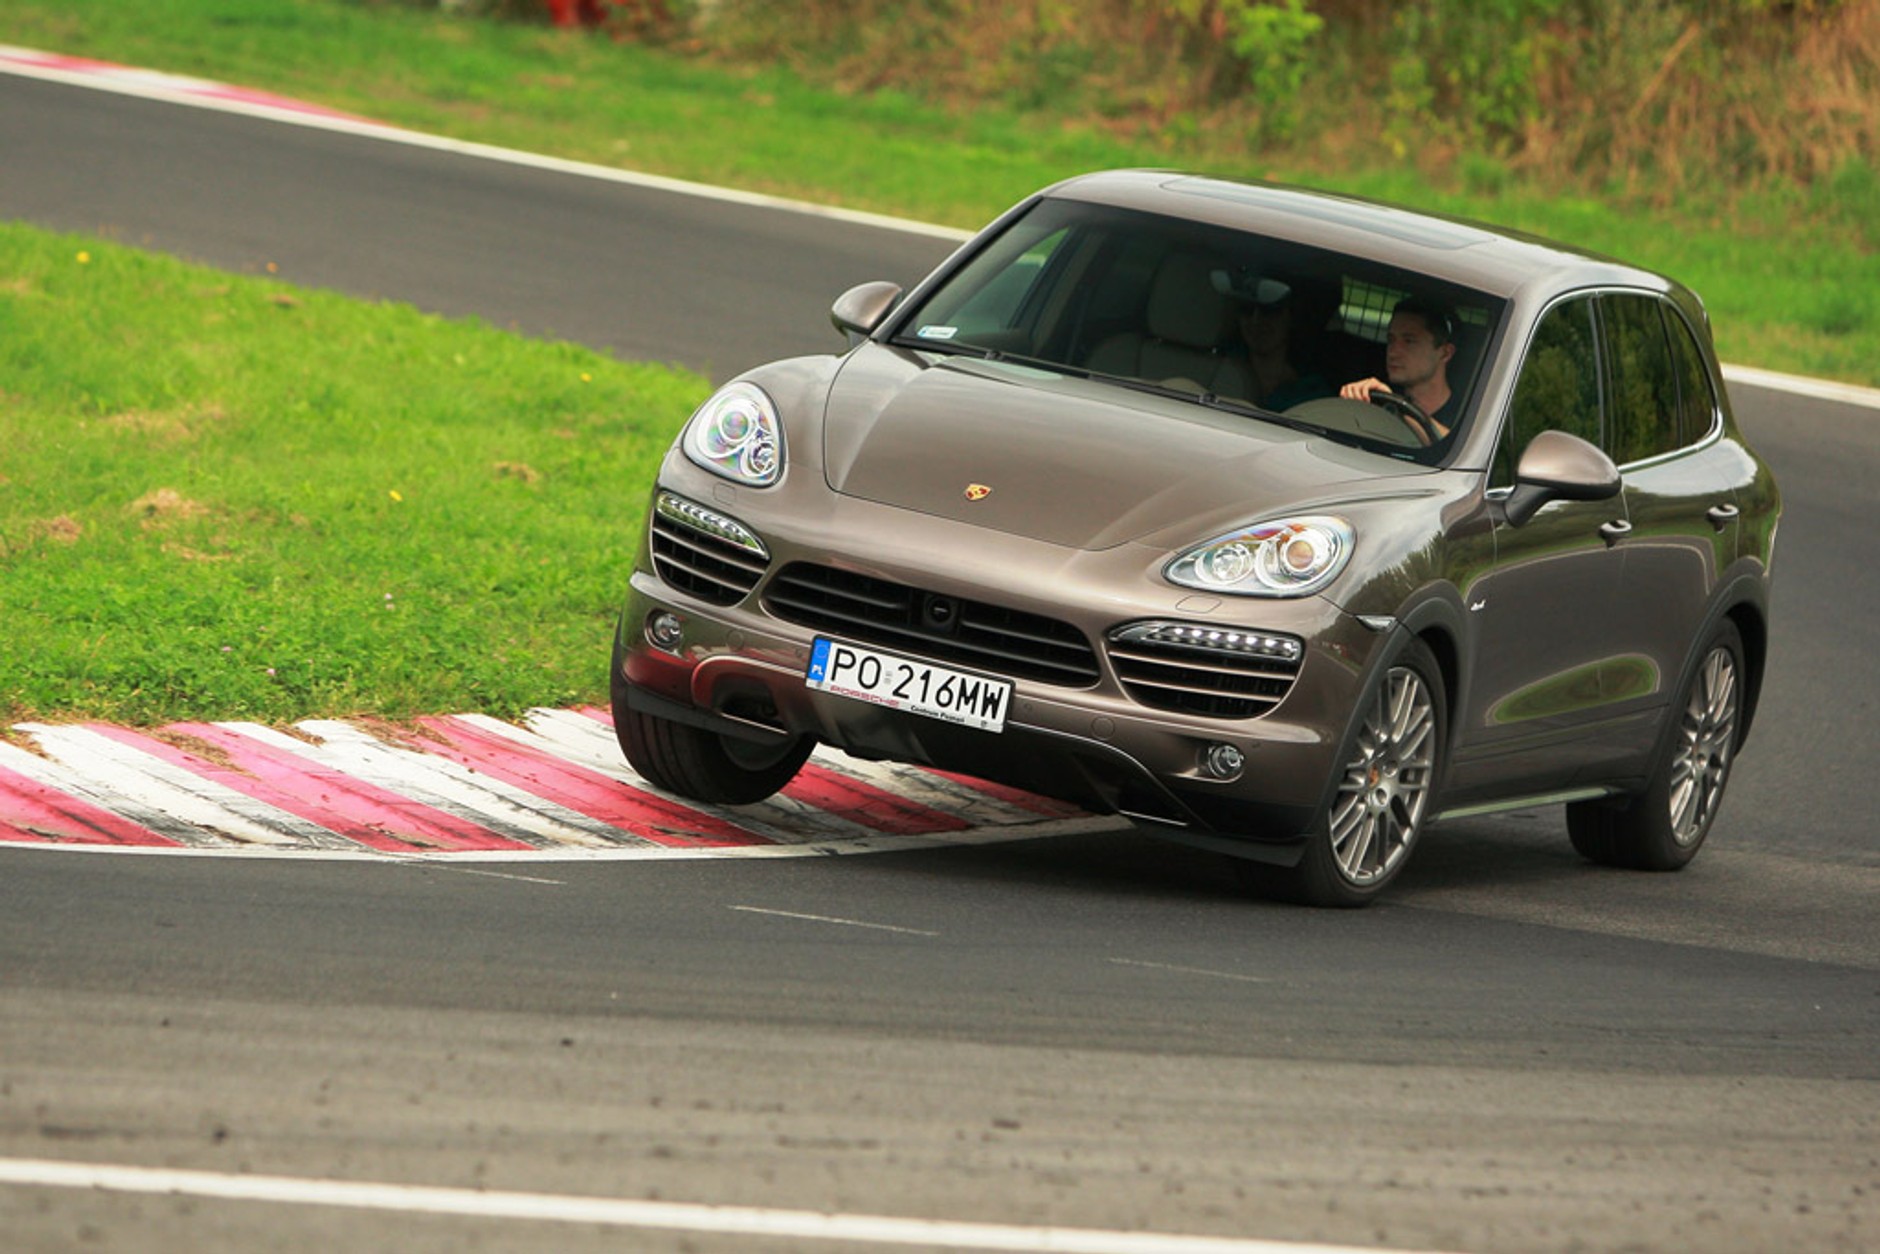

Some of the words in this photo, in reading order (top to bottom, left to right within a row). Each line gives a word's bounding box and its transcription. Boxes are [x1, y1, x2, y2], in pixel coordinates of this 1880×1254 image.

[811, 664, 824, 676] PL
[830, 648, 881, 689] PO
[892, 664, 1004, 719] 216MW
[830, 685, 899, 708] PORSCHE
